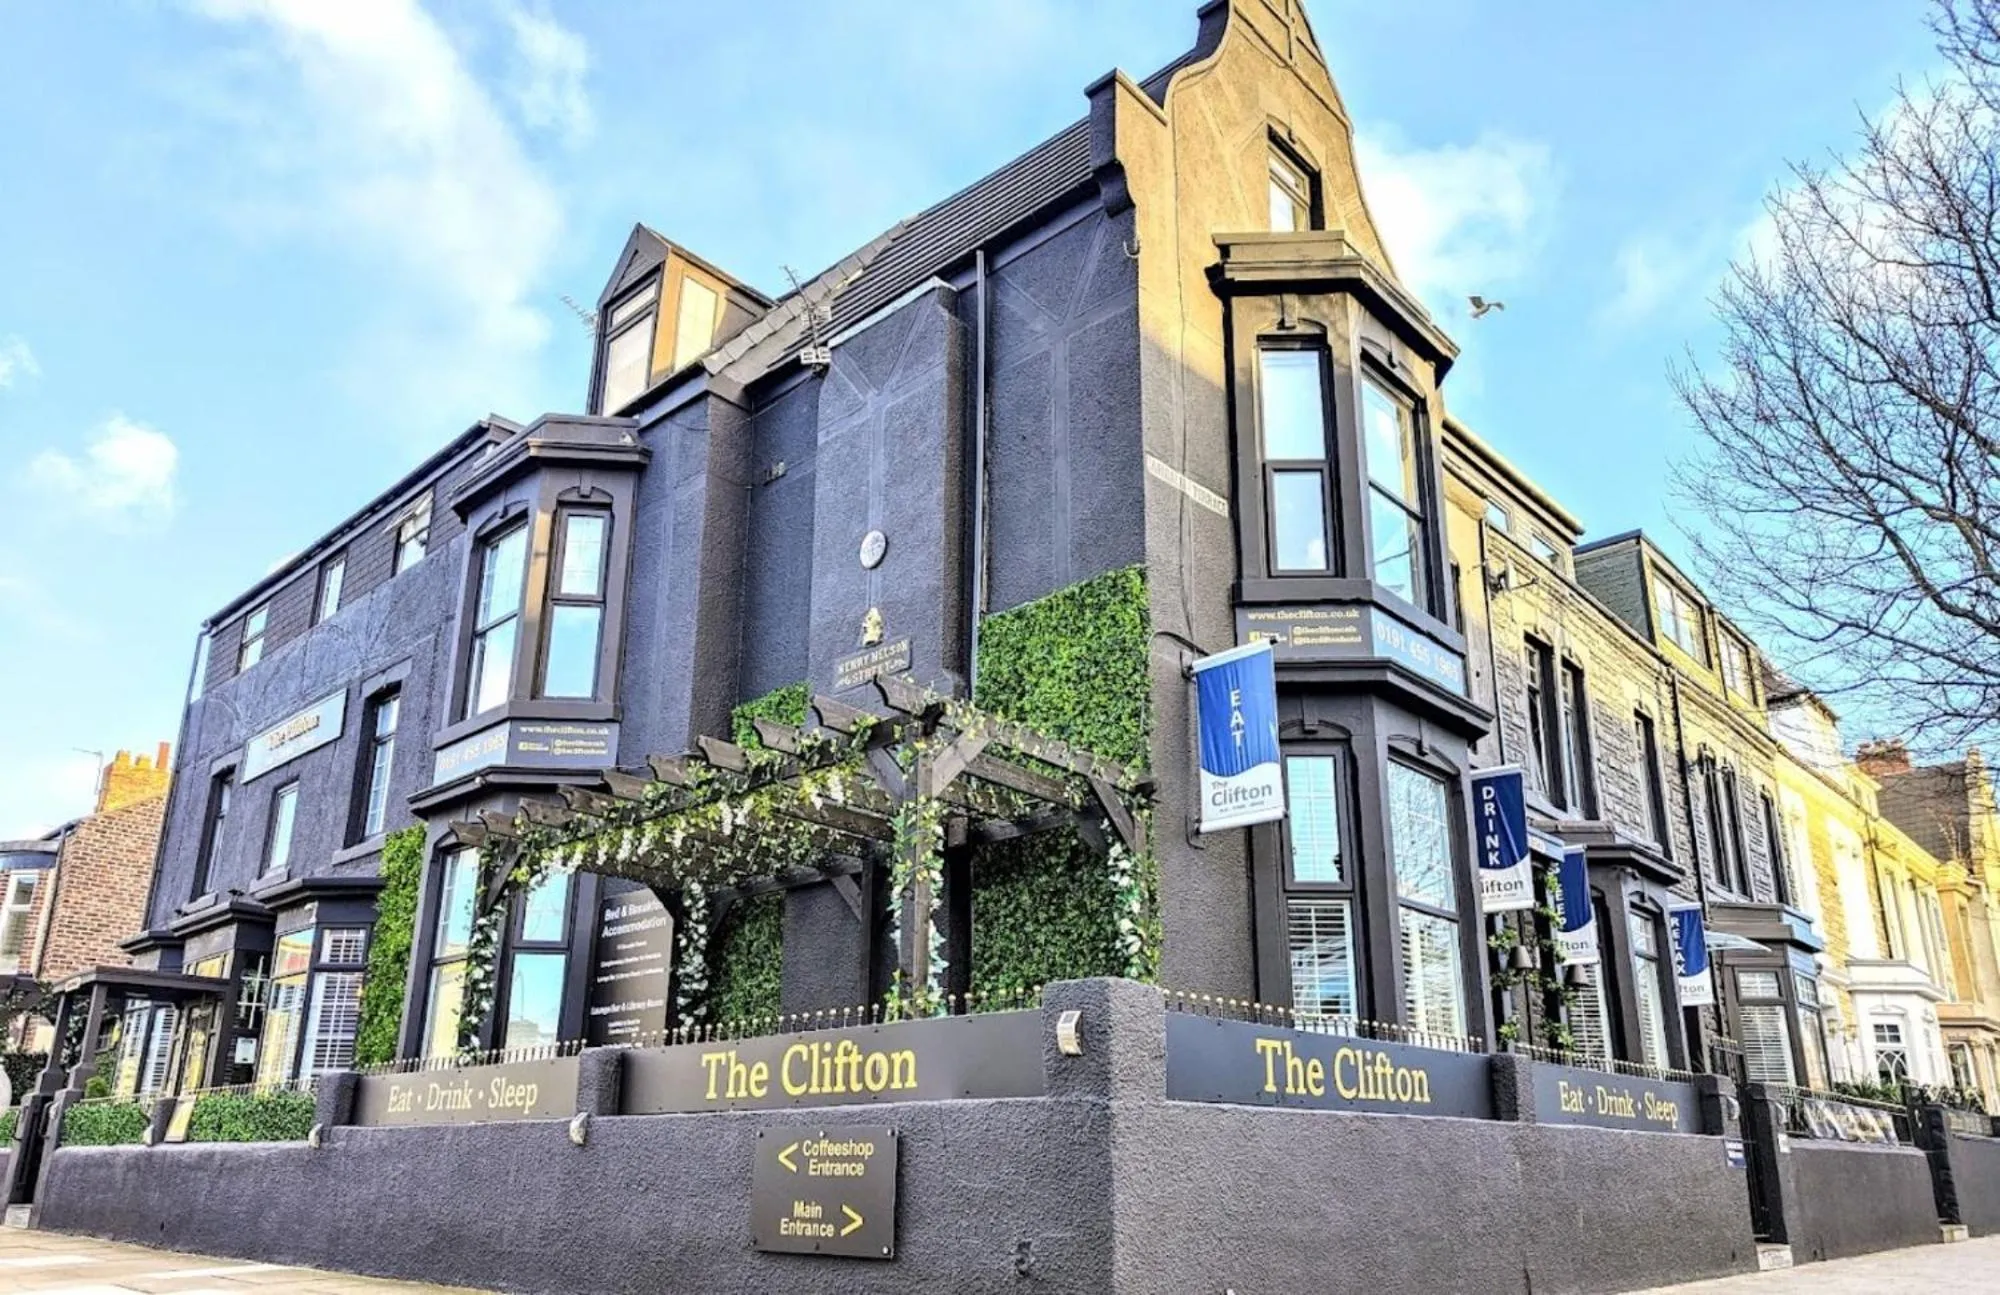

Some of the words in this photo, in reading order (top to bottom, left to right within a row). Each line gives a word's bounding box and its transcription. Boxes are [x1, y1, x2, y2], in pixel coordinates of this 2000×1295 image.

[1247, 608, 1360, 620] www.theclifton.co.uk
[1376, 621, 1405, 653] 0191
[1230, 690, 1244, 748] EAT
[1211, 780, 1228, 790] The
[1211, 784, 1272, 807] Clifton
[1482, 786, 1500, 866] DRINK
[1481, 879, 1523, 894] lifton
[604, 906, 620, 921] Bed
[601, 916, 666, 938] Accommodation
[1671, 917, 1686, 974] RELAX
[702, 1050, 769, 1100] The
[781, 1039, 918, 1096] Clifton
[1256, 1038, 1325, 1097] The
[1334, 1047, 1431, 1104] Clifton
[387, 1085, 412, 1113] Eat
[426, 1079, 473, 1111] Drink
[488, 1077, 538, 1114] Sleep
[1558, 1080, 1585, 1113] Eat
[1596, 1085, 1636, 1118] Drink
[1644, 1090, 1679, 1129] Sleep
[803, 1139, 875, 1160] Coffeeshop
[808, 1158, 865, 1176] Entrance
[793, 1200, 823, 1219] Main
[780, 1218, 835, 1237] Entrance
